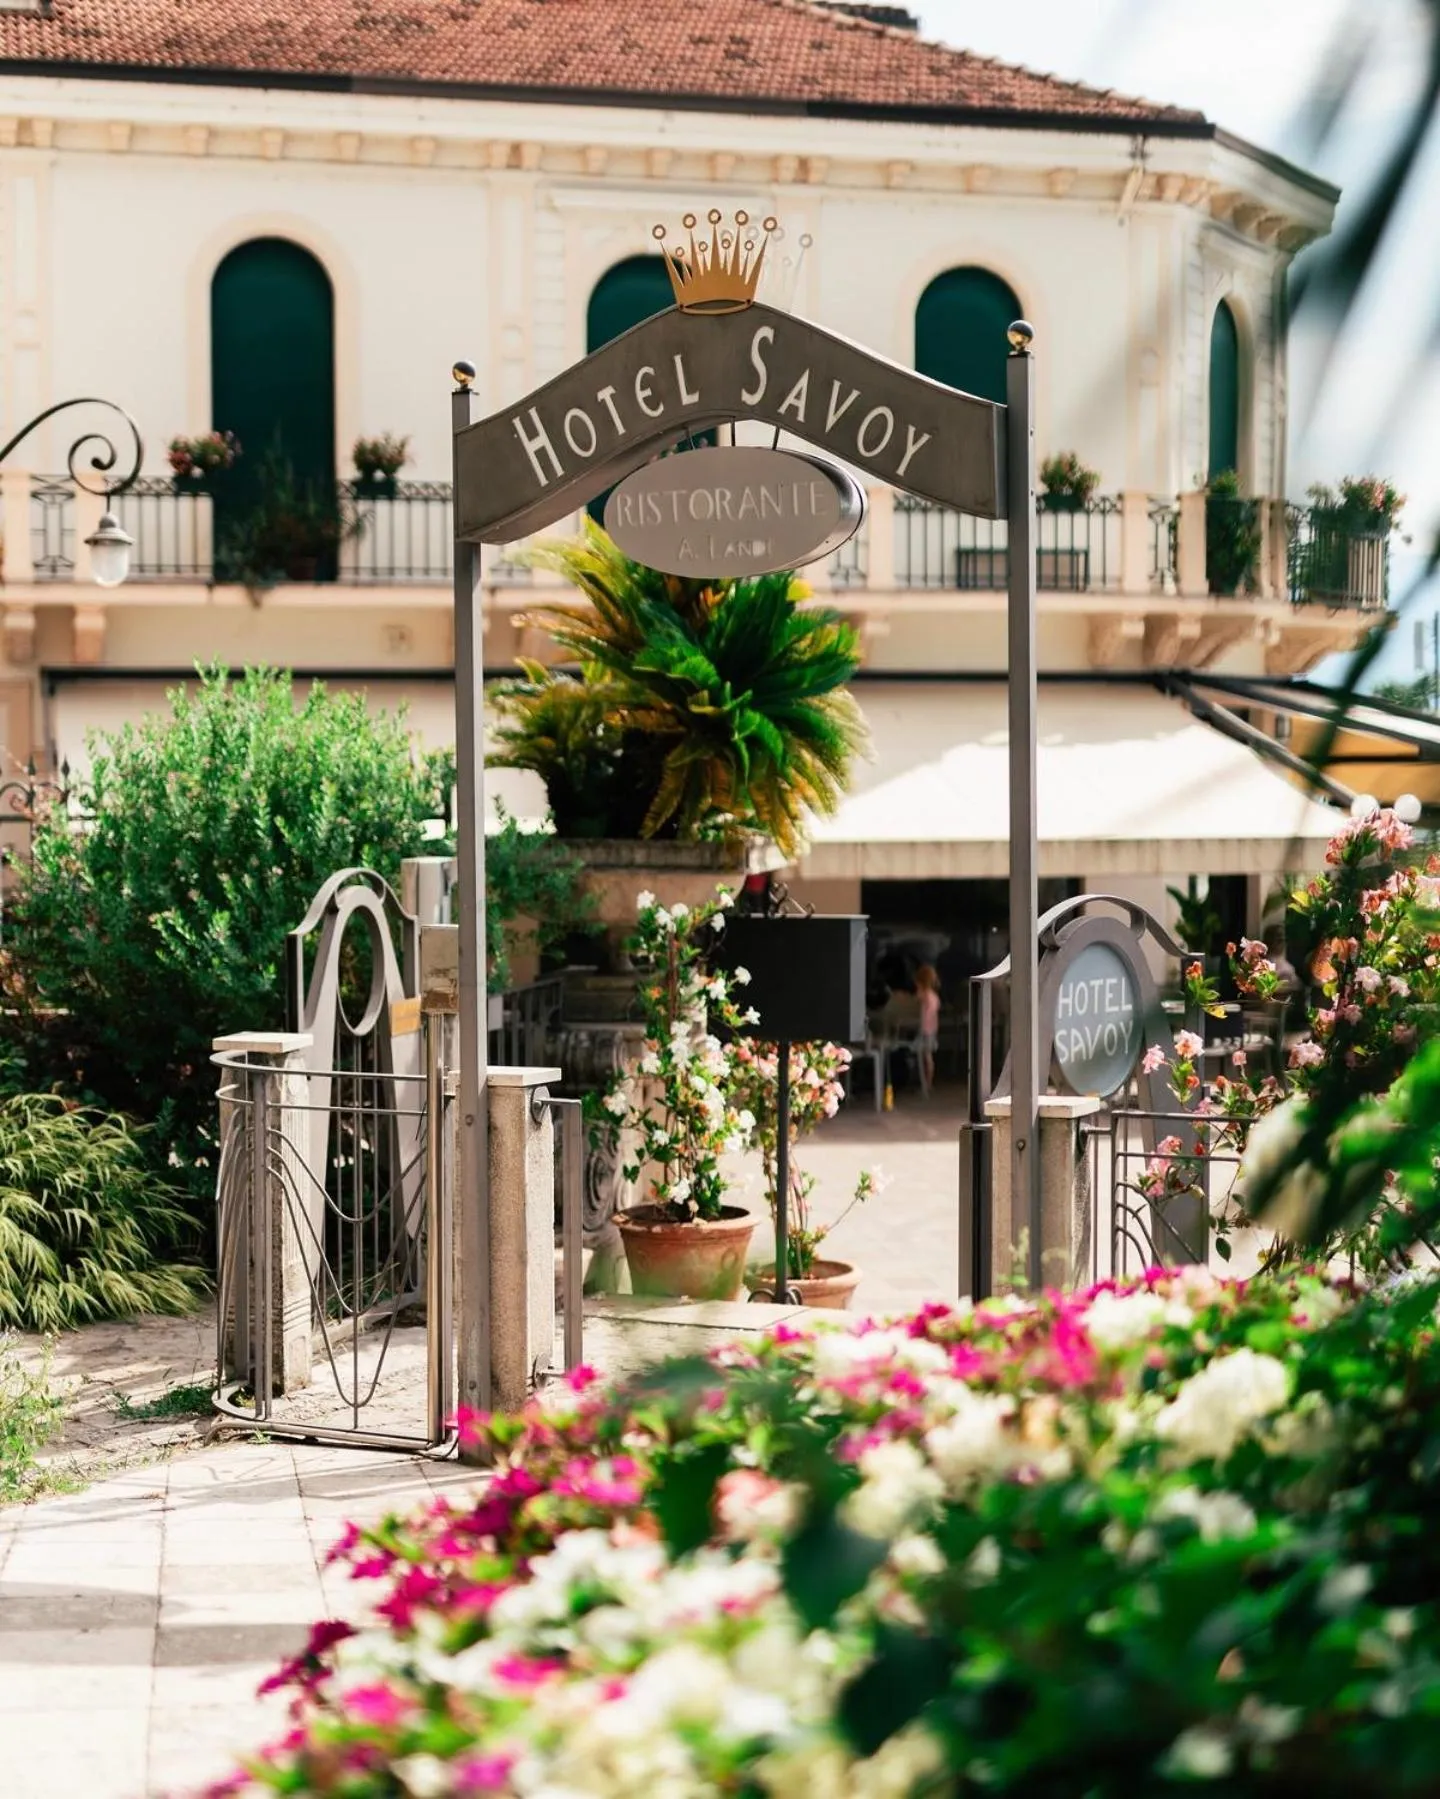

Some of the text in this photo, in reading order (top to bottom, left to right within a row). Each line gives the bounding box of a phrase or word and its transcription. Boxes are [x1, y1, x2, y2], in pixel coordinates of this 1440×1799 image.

[512, 325, 932, 487] HOTEL SAVOY
[616, 480, 829, 528] RISTORANTE
[1057, 976, 1133, 1019] HOTEL
[1055, 1019, 1134, 1065] SAVOY
